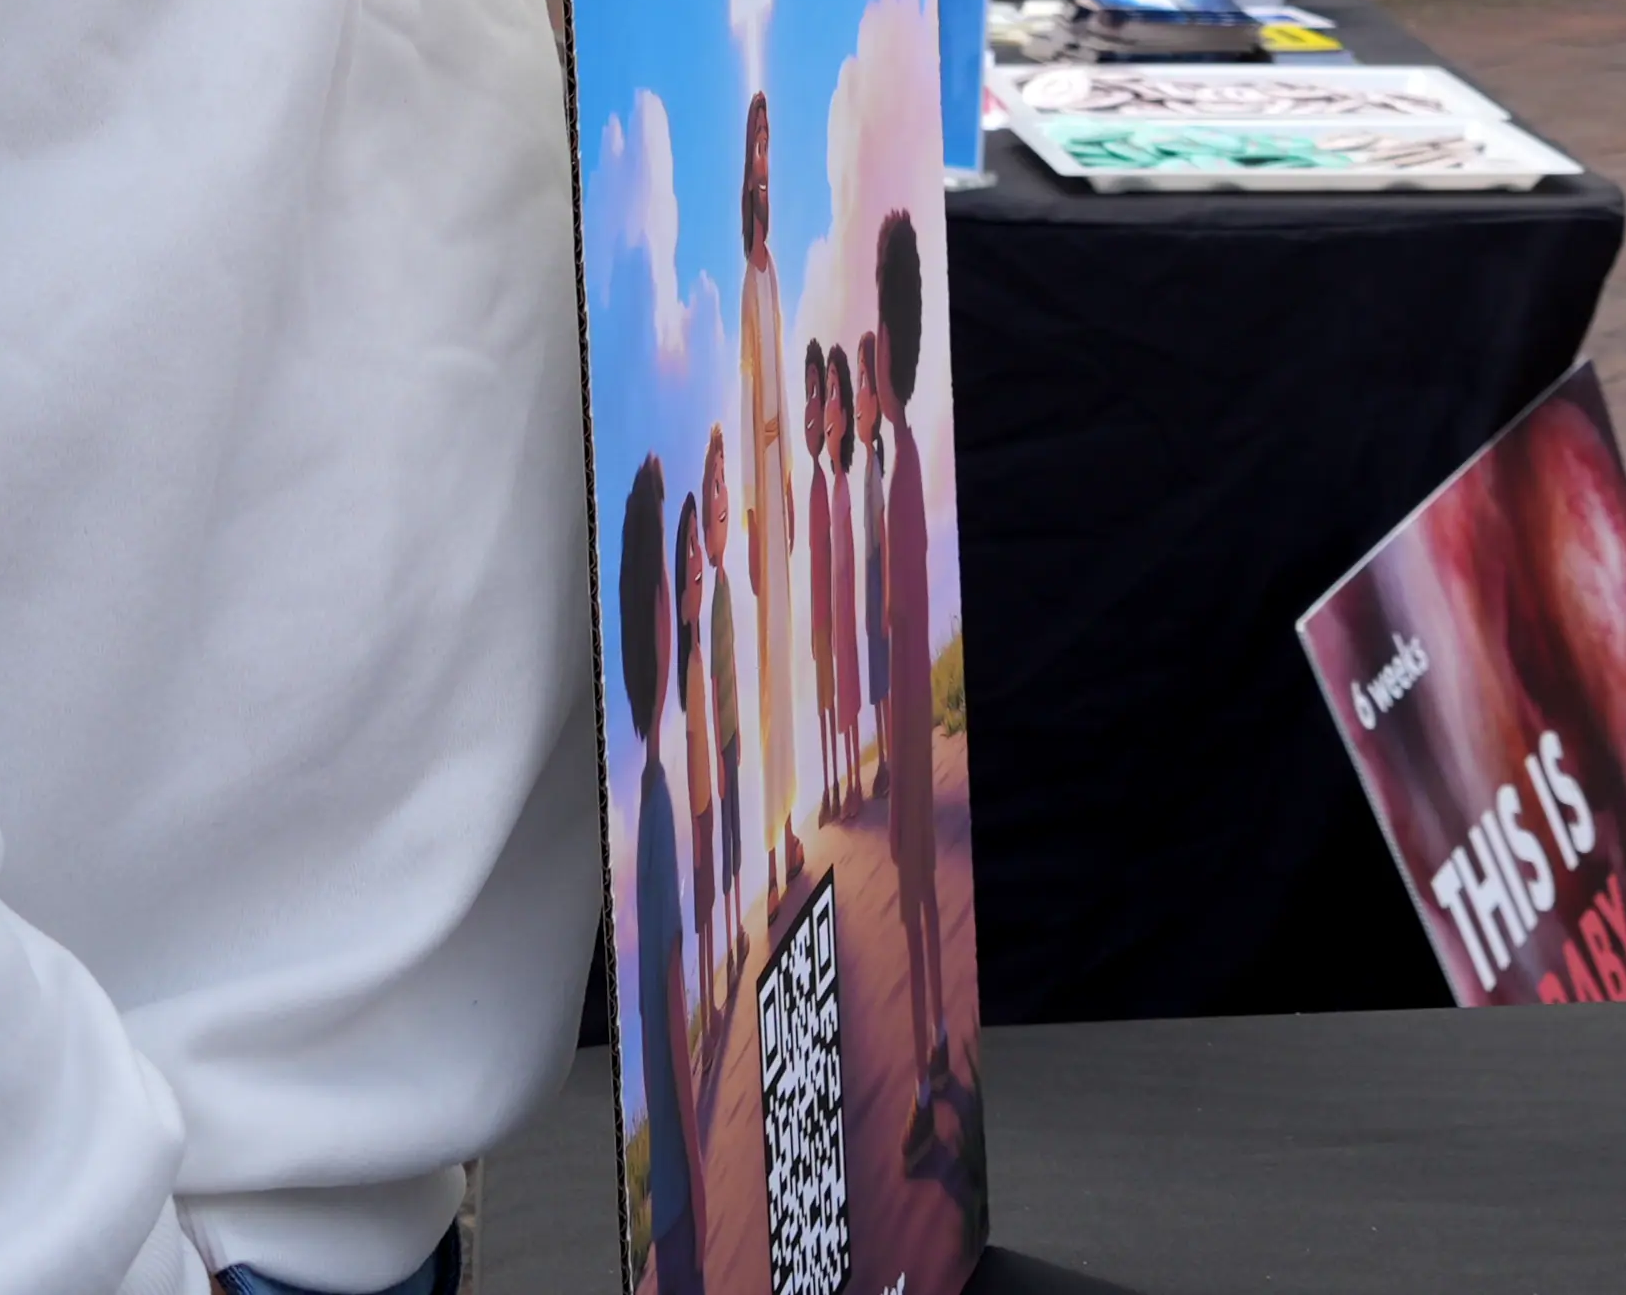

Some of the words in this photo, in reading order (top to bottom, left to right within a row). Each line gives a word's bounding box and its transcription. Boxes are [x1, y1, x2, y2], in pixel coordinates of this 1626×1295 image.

[1351, 679, 1377, 730] 6
[1367, 631, 1429, 713] weeks
[1430, 783, 1556, 992] THIS
[1524, 730, 1596, 871] IS
